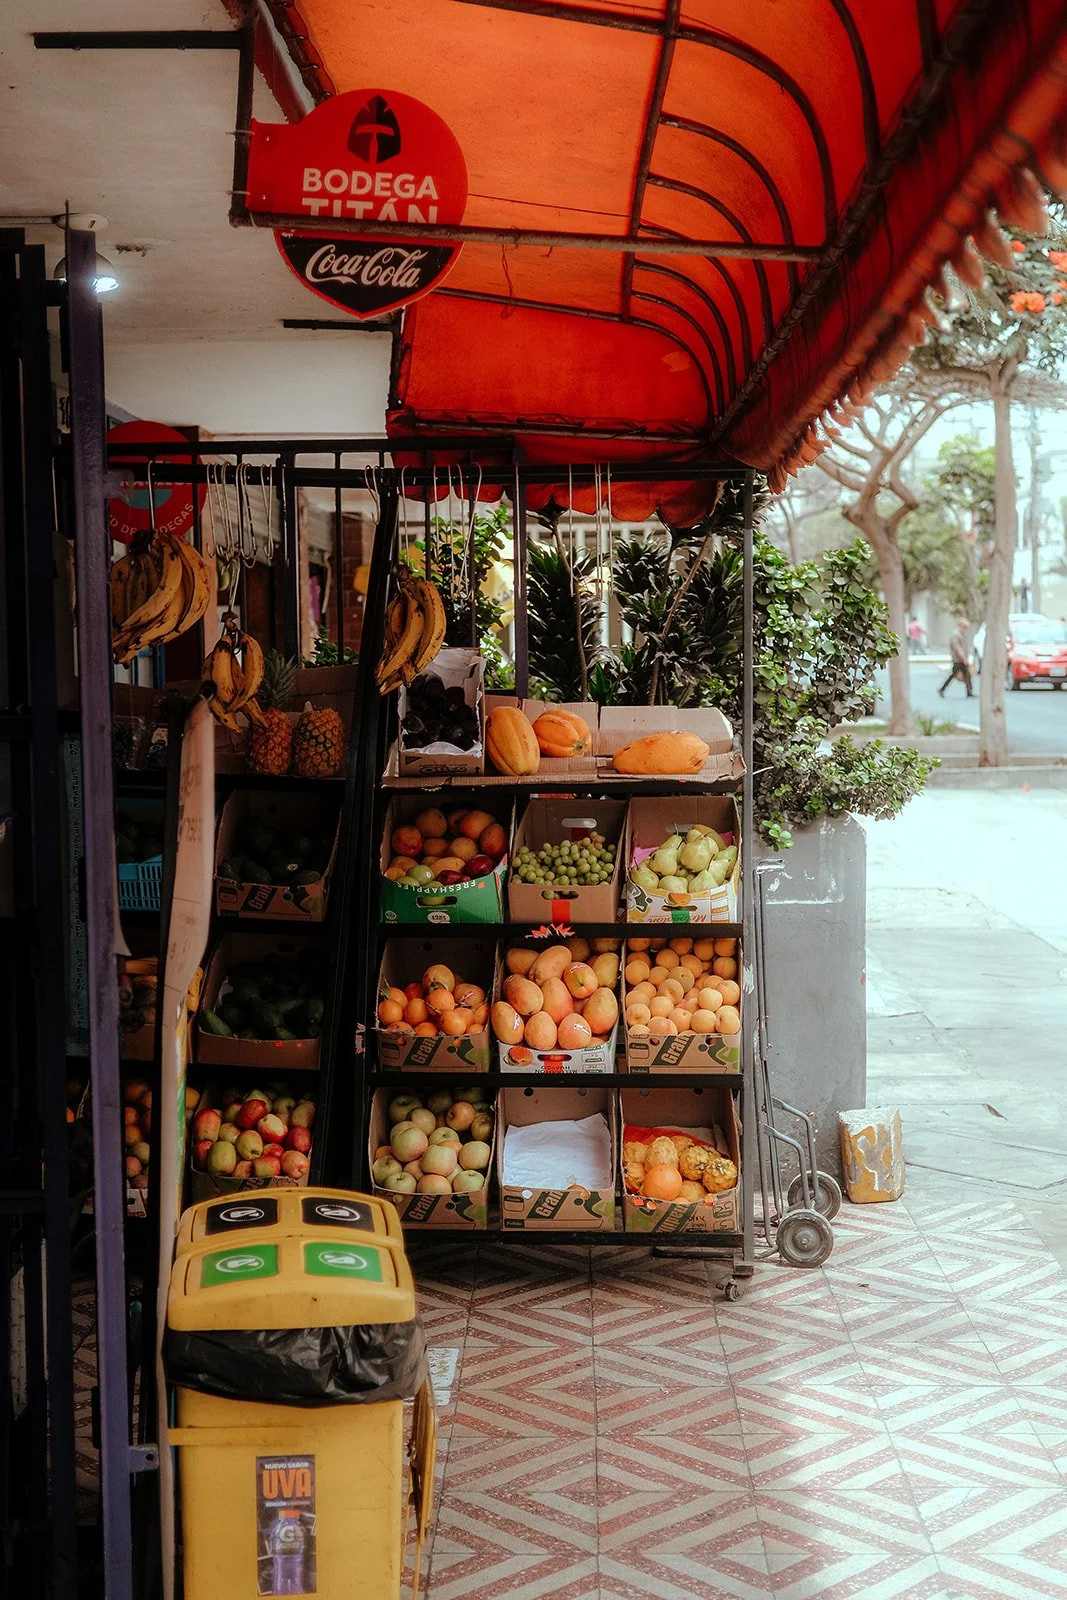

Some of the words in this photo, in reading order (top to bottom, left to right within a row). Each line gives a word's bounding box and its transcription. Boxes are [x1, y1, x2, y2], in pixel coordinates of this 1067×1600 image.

[303, 168, 438, 199] BODEGA
[302, 198, 438, 224] TITÁN
[305, 243, 429, 288] Coca-Cola
[262, 1468, 311, 1499] UVA
